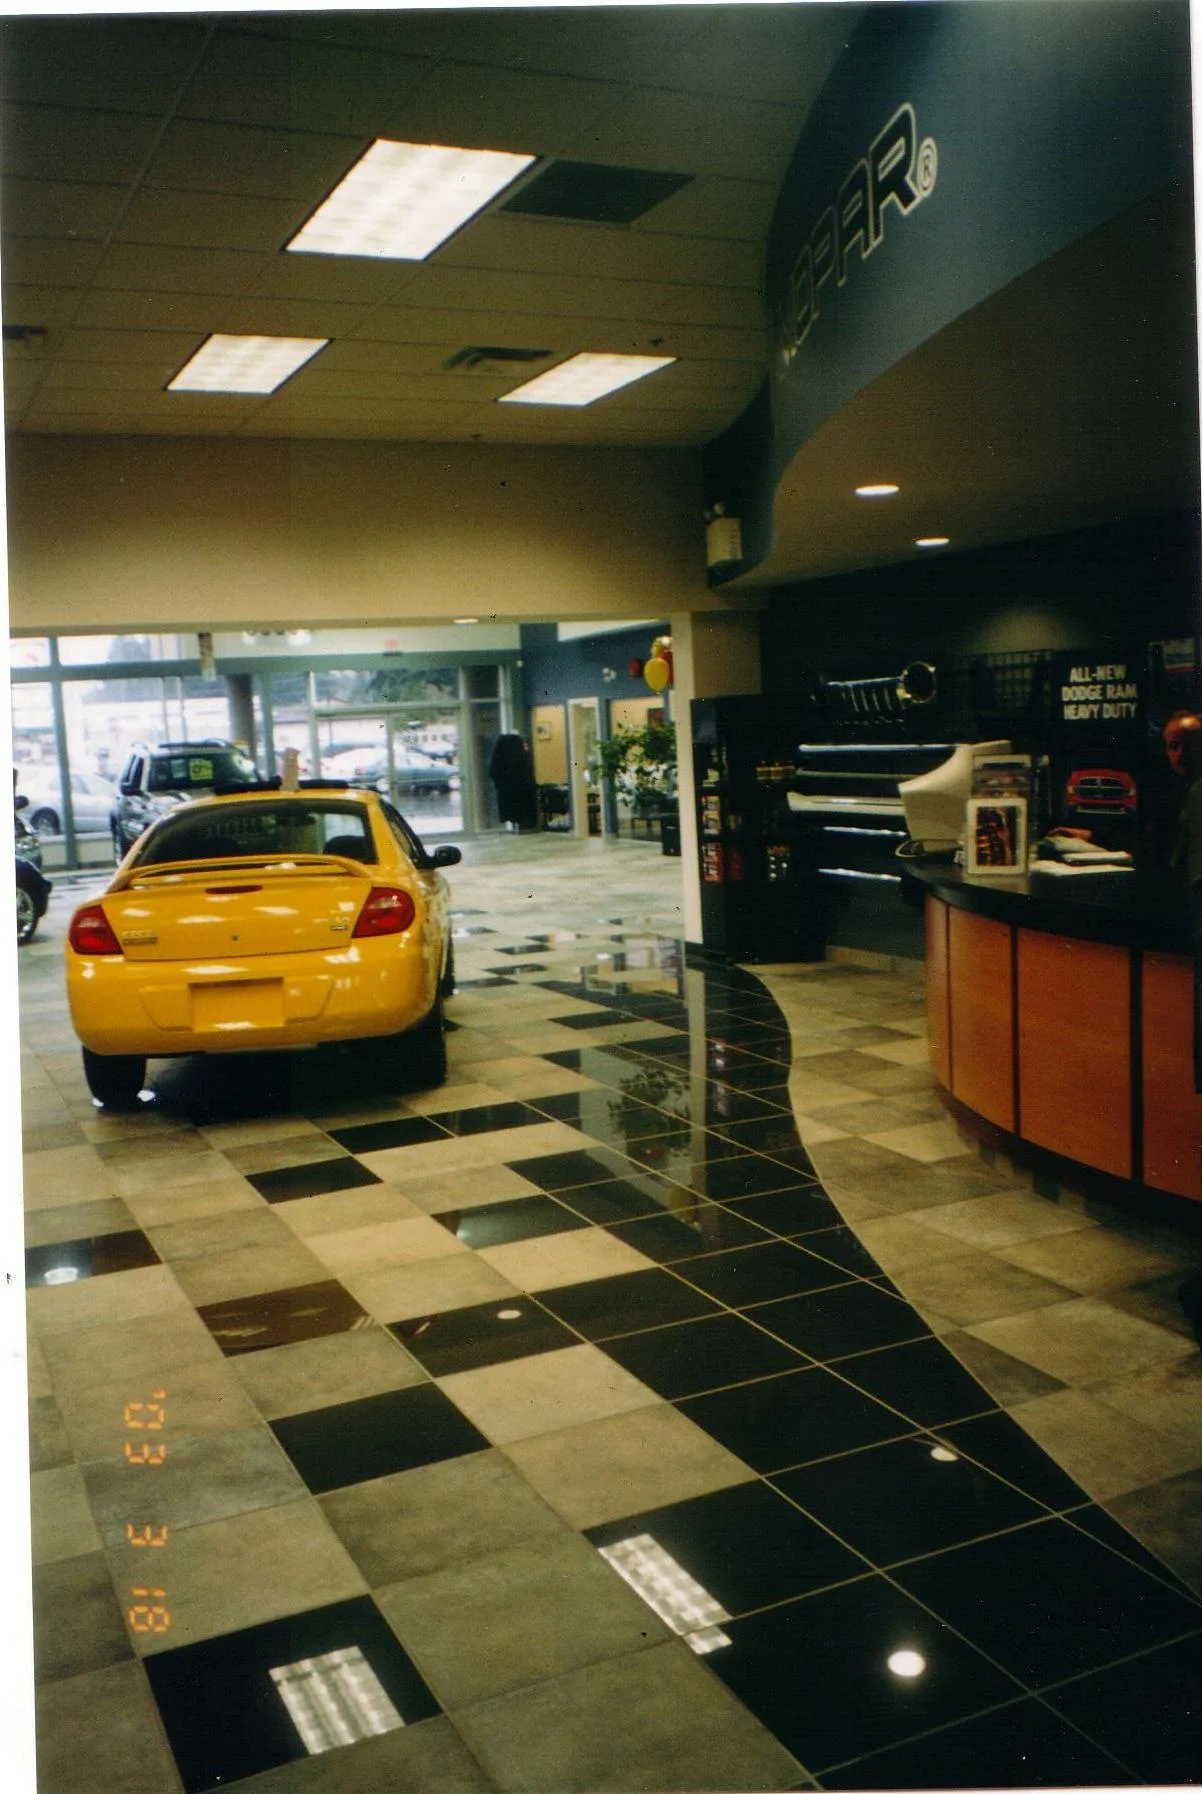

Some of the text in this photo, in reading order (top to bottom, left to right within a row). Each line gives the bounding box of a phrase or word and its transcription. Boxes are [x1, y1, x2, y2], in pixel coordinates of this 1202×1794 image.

[1070, 664, 1127, 682] ALL-NEW
[1062, 684, 1137, 701] DODGE RAM
[1064, 703, 1137, 720] HEAVY DUTY
